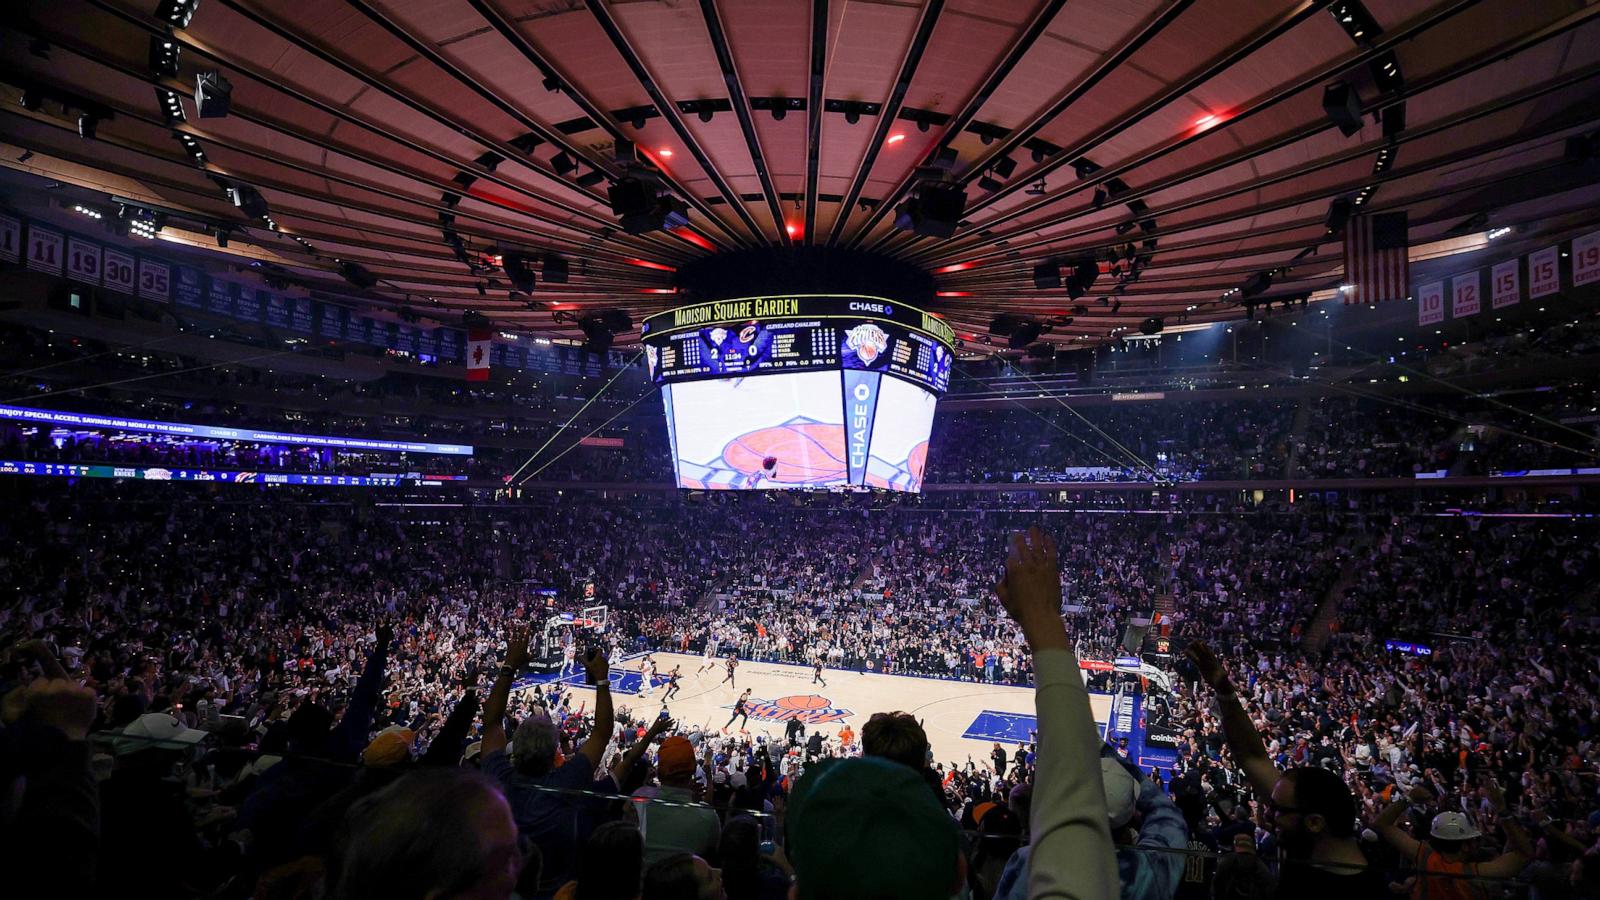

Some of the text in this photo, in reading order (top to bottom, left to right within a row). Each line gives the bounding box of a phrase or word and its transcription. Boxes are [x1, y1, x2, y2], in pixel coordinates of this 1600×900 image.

[35, 241, 55, 264] 11
[73, 251, 96, 274] 19
[1577, 248, 1600, 270] 19
[107, 261, 131, 284] 30
[142, 271, 167, 293] 35
[1534, 262, 1553, 283] 15
[1496, 273, 1514, 295] 15
[1423, 294, 1440, 312] 10
[1457, 285, 1475, 304] 12
[675, 298, 798, 326] MADISON SQUARE GARDEN
[849, 302, 884, 313] CHASE
[766, 322, 794, 330] CLEVELAND
[711, 348, 718, 359] 2
[748, 345, 757, 357] 0
[0, 408, 24, 417] ENJOY
[24, 411, 53, 420] SPECIAL
[54, 414, 81, 423] ACCESS,
[82, 417, 112, 426] SAVINGS
[112, 420, 127, 428] AND
[209, 429, 230, 437] CHASE
[253, 433, 291, 442] CARDHOLDERS
[852, 404, 868, 468] CHASE
